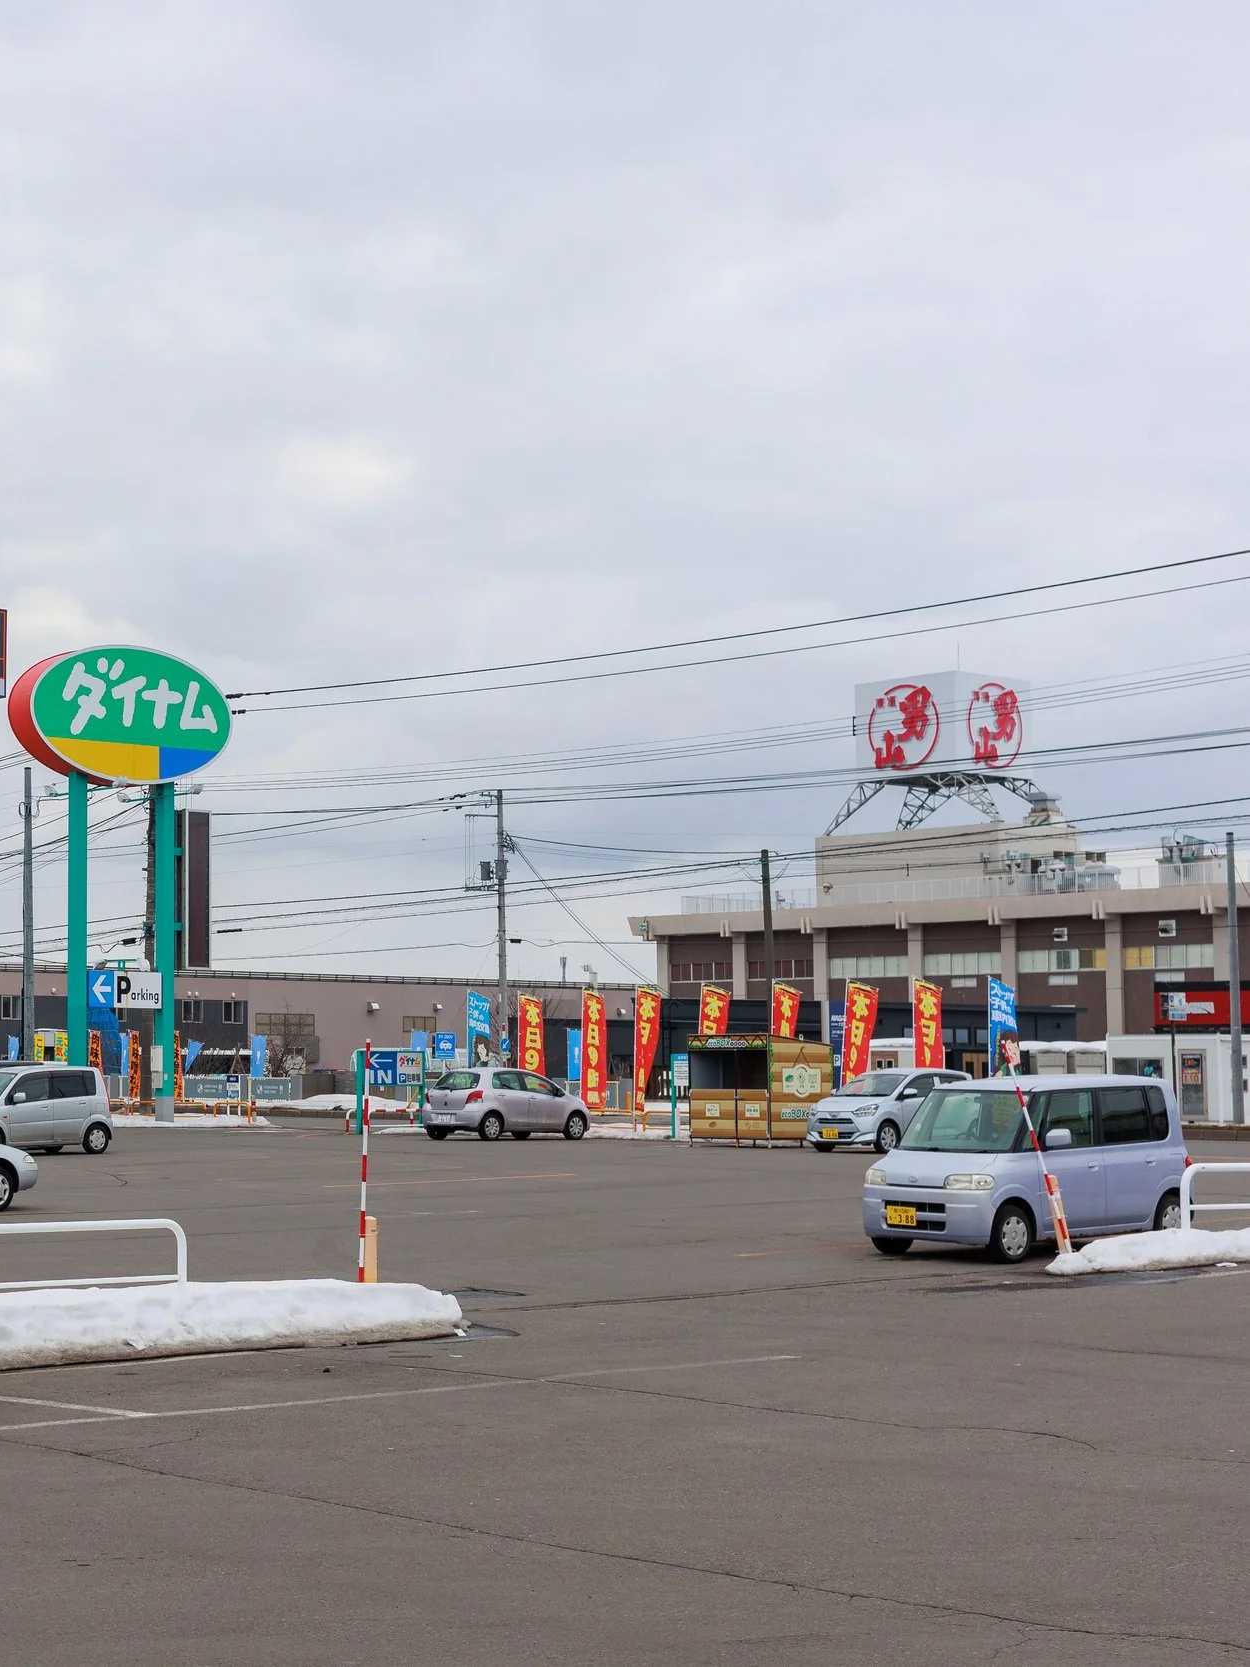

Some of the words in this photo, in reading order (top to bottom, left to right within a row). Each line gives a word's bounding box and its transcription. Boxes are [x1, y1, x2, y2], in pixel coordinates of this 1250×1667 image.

[62, 657, 218, 735] ダイナム
[116, 975, 160, 1005] Parking
[369, 1069, 392, 1084] IN
